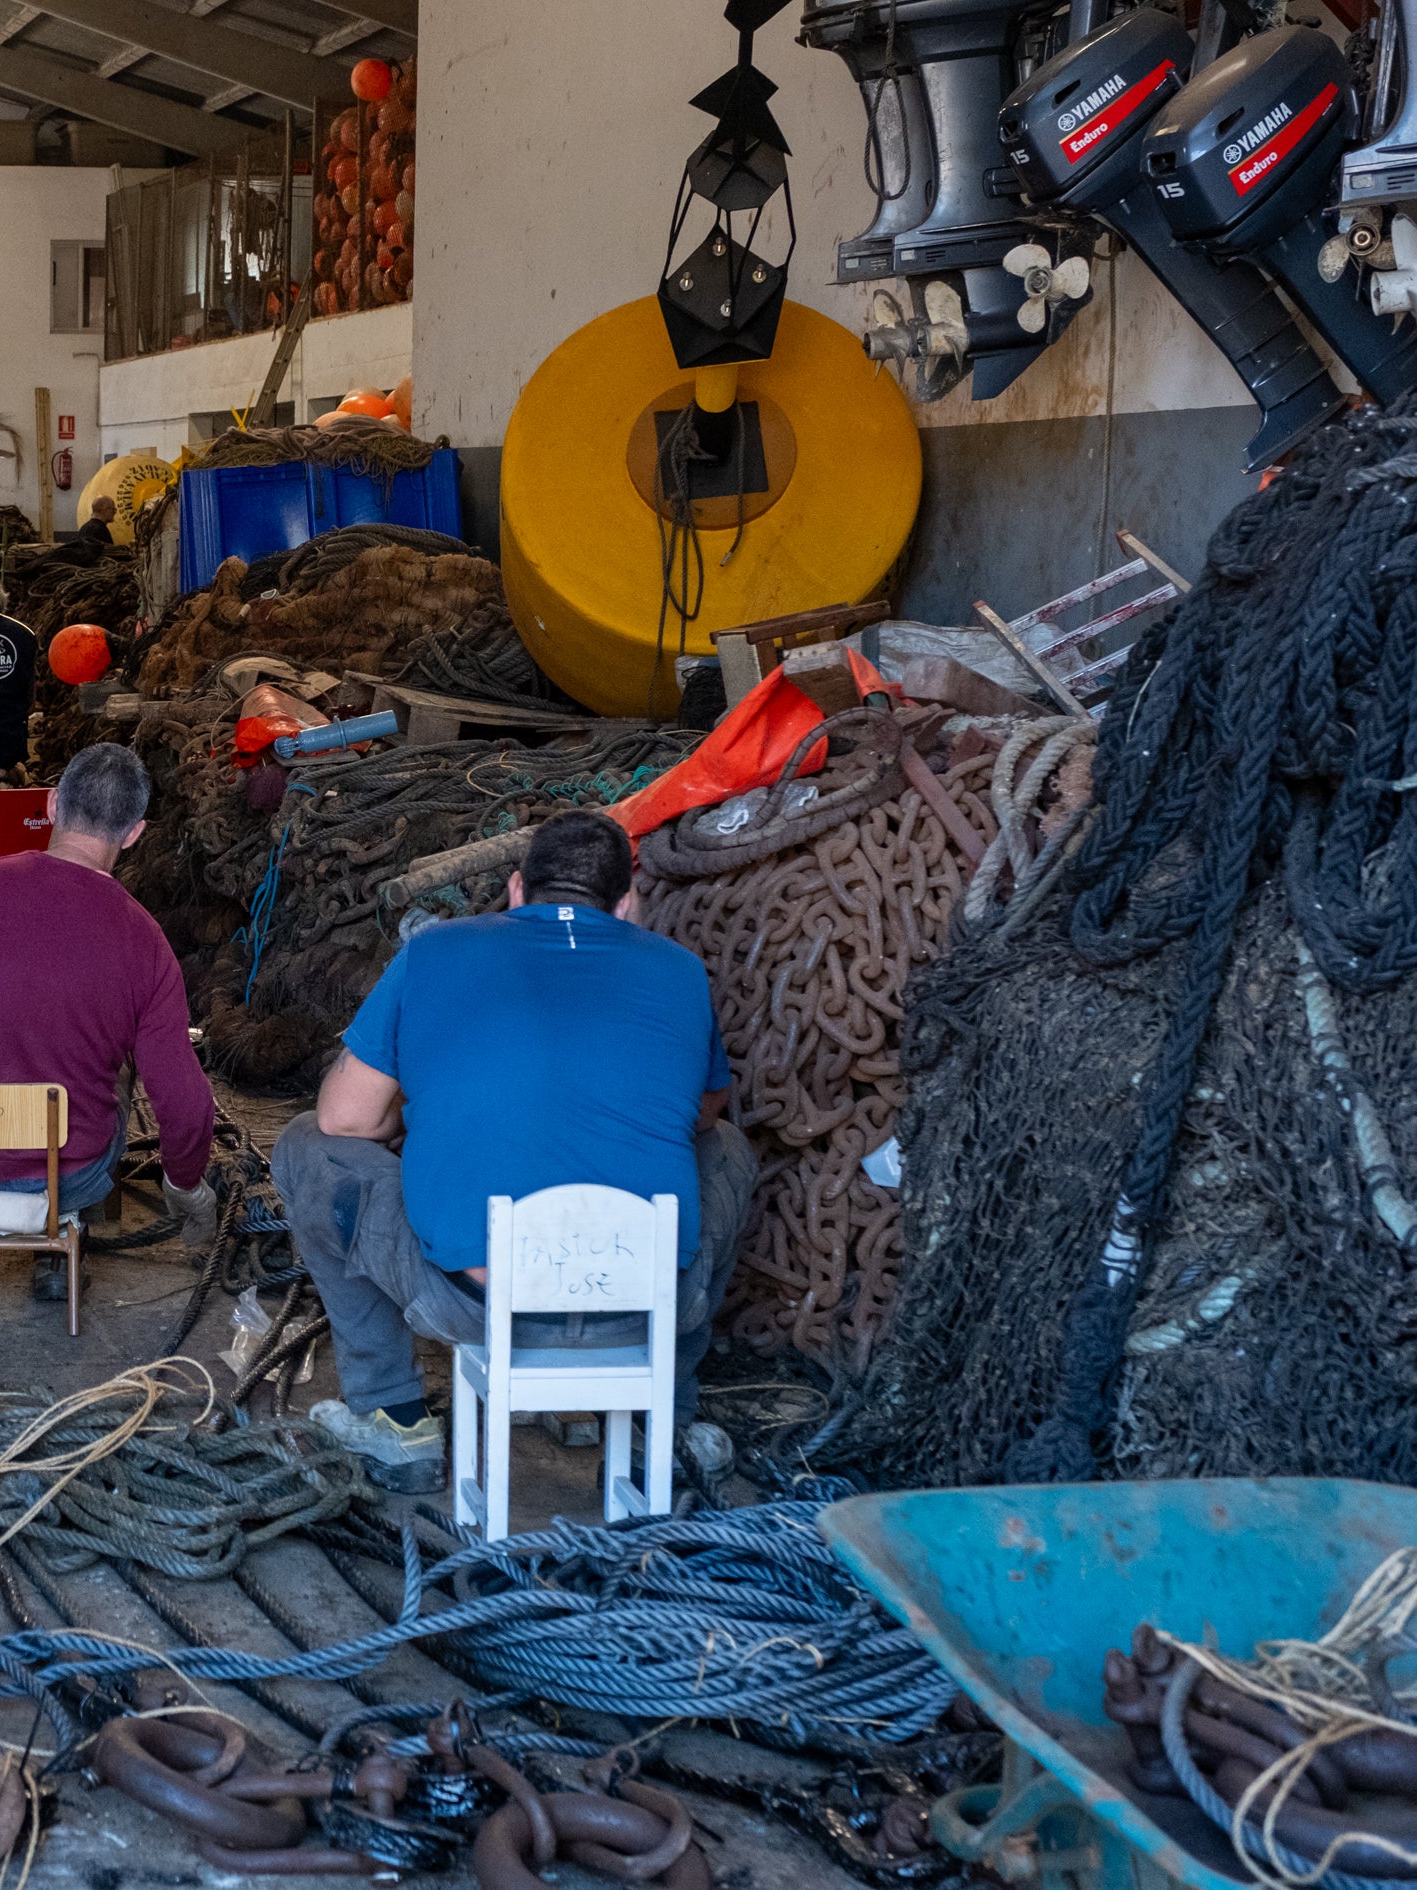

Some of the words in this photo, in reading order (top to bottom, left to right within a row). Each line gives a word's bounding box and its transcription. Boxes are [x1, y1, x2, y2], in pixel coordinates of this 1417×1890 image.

[1071, 74, 1128, 121] YAMAHA
[1069, 122, 1109, 153] Enduro
[1237, 102, 1293, 152] YAMAHA
[1010, 149, 1030, 165] 15
[1238, 151, 1279, 185] Enduro
[1156, 182, 1186, 199] 15
